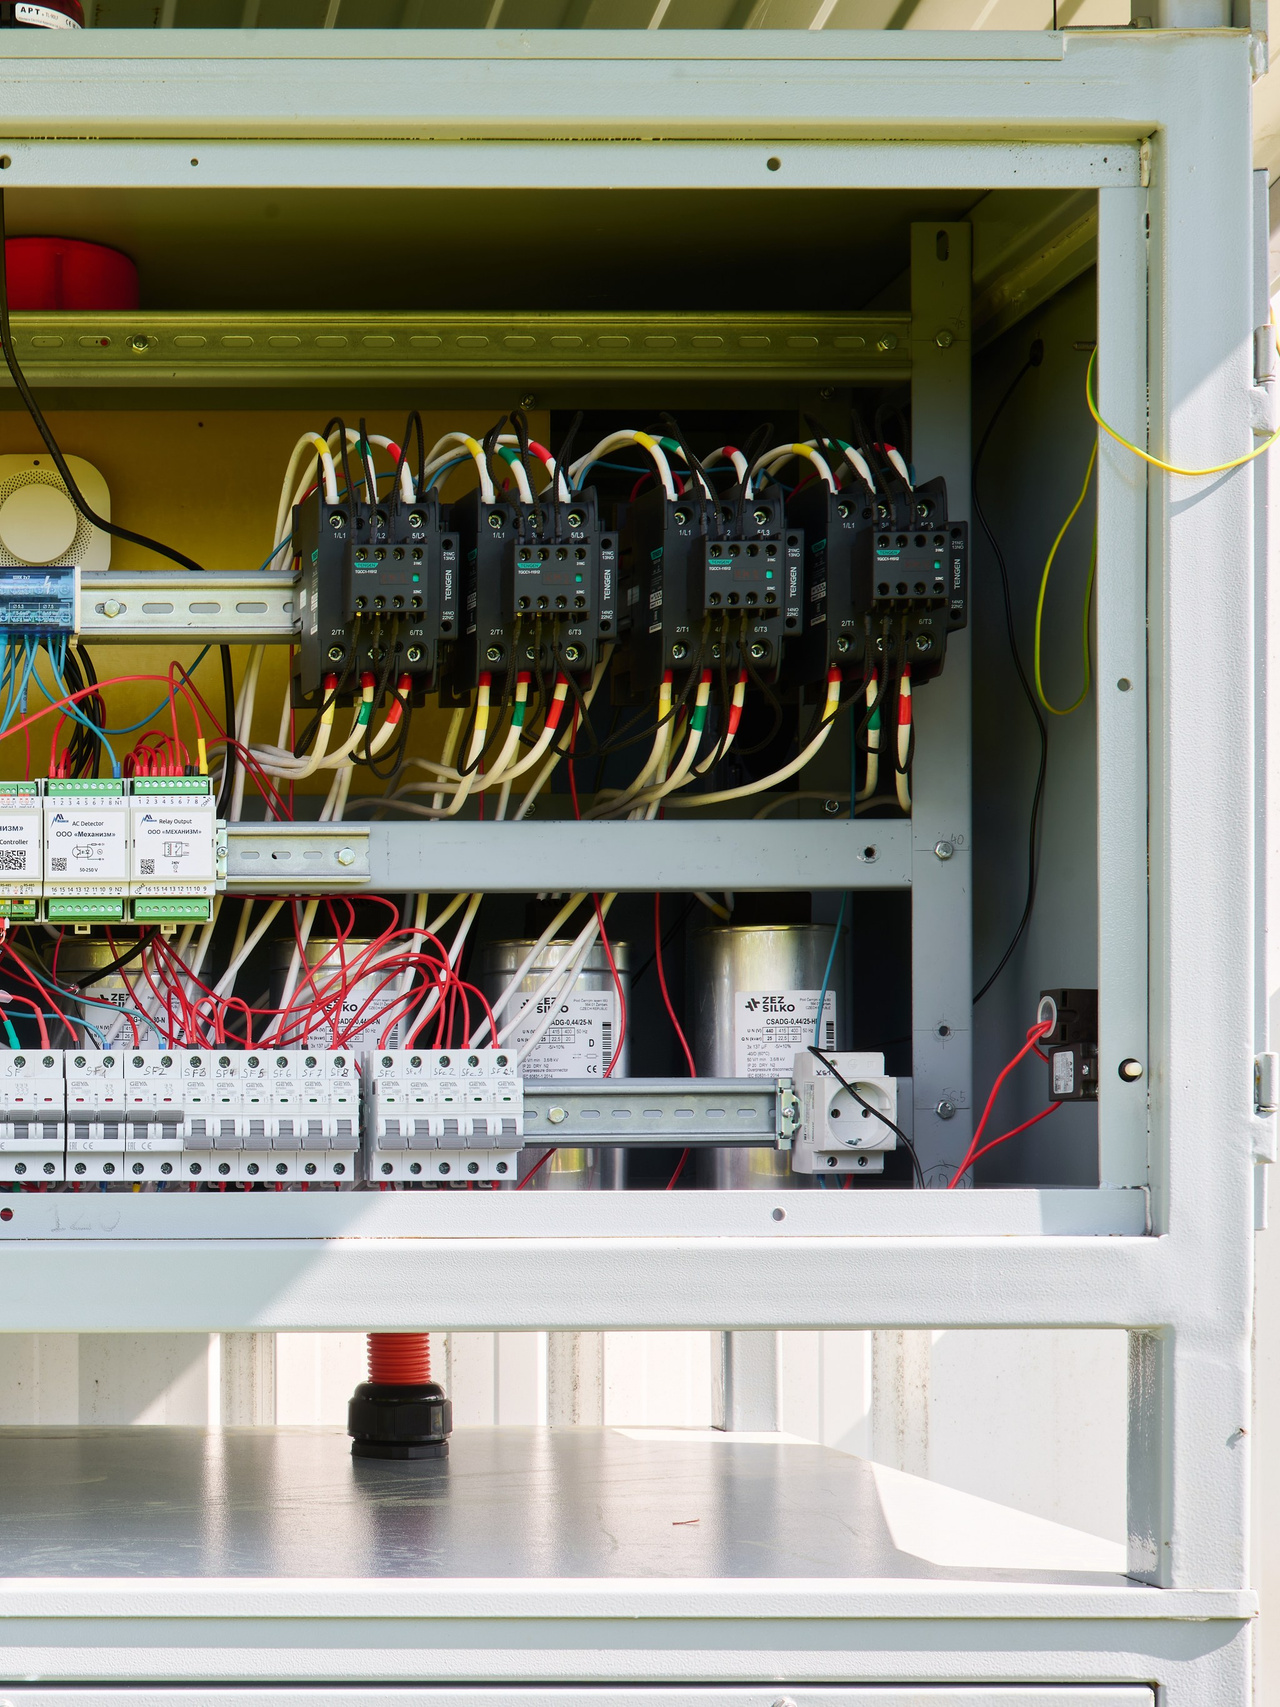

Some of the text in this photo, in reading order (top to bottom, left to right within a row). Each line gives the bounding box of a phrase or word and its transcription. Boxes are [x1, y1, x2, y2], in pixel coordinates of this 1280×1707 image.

[20, 6, 40, 15] APT
[951, 833, 964, 845] 40
[762, 996, 784, 1004] ZEZ
[762, 1004, 796, 1012] SILKO
[588, 1039, 594, 1047] D
[144, 1066, 167, 1076] SF2
[184, 1068, 207, 1077] SF3
[273, 1069, 292, 1078] SF6
